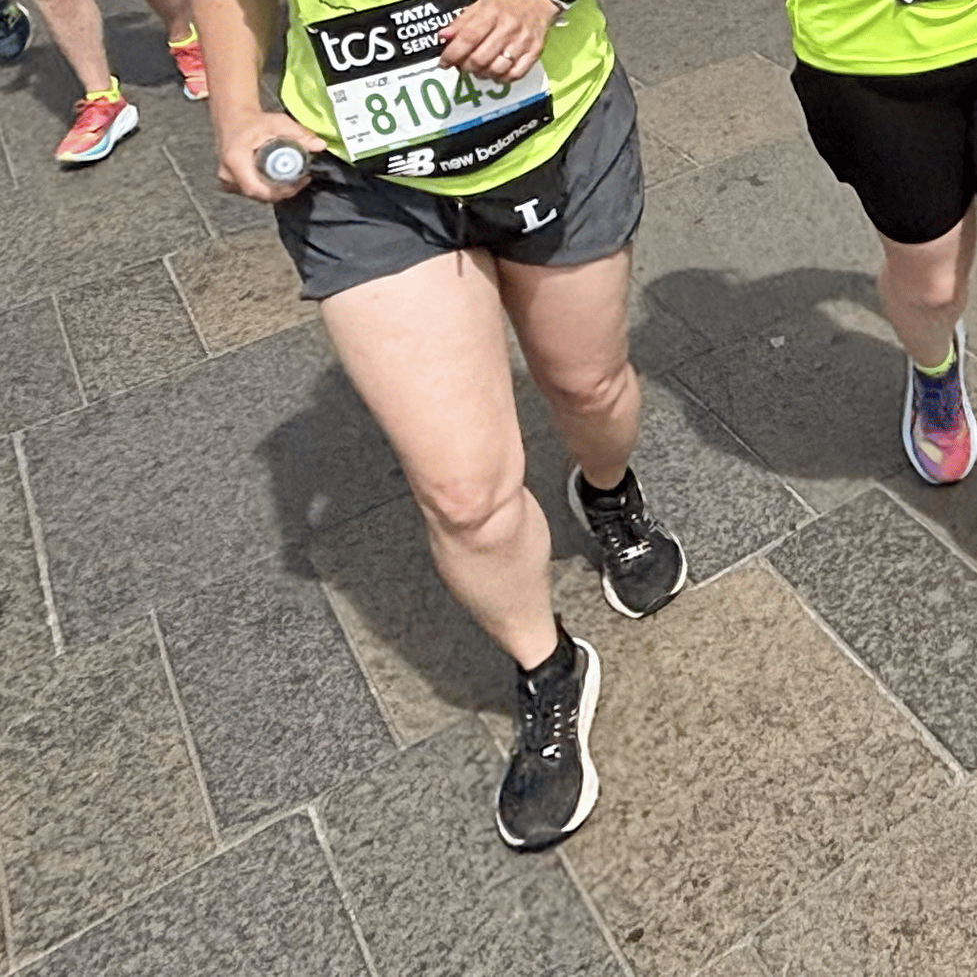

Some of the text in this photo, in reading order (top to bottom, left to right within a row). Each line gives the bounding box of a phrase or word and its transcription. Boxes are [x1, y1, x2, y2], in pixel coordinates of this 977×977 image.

[390, 2, 439, 25] TATA
[320, 26, 395, 71] tcs
[439, 152, 474, 172] new
[474, 118, 538, 163] balance
[514, 198, 557, 233] L
